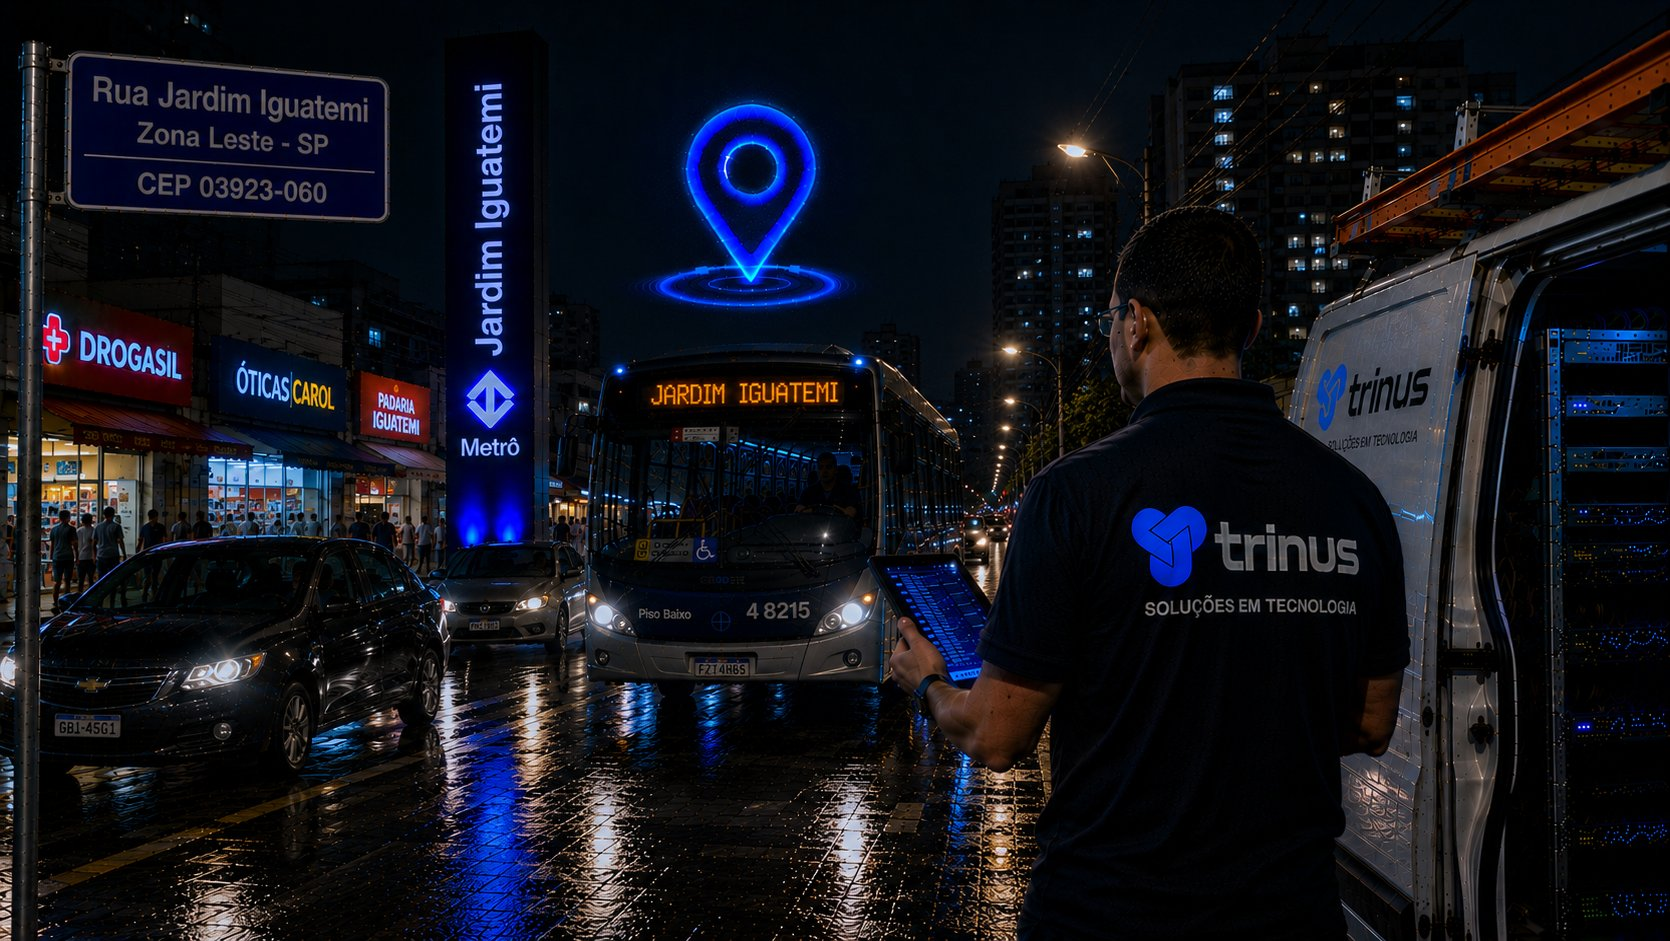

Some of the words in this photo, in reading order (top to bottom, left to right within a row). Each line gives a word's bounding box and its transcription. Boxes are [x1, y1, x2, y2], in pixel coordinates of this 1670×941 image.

[92, 75, 149, 106] Rua
[158, 81, 251, 114] Jardim
[260, 88, 369, 123] Iguatemi
[136, 121, 200, 147] Zona
[208, 126, 274, 152] Leste
[297, 133, 329, 155] SP
[473, 82, 510, 229] Iguatemi
[137, 171, 192, 197] CEP
[199, 175, 328, 204] 03923-060
[474, 239, 503, 356] Jardim
[79, 330, 182, 381] DROGASIL
[236, 360, 290, 403] ÓTICAS
[292, 378, 335, 411] CAROL
[651, 383, 726, 405] JARDIM
[739, 381, 839, 404] IGUATEMI
[1348, 367, 1432, 417] trinus
[377, 391, 415, 415] PADARIA
[372, 410, 420, 436] IGUATEMI
[1373, 430, 1418, 447] TECNOLOGIA
[460, 437, 520, 458] Metrô
[1214, 521, 1360, 576] trinus
[638, 608, 661, 620] Piso
[663, 608, 692, 620] Baixo
[746, 602, 759, 620] 4
[763, 601, 811, 620] 8215
[1144, 594, 1235, 619] SOLUÇÕES
[1238, 598, 1261, 613] EM
[1265, 598, 1357, 616] TECNOLOGIA
